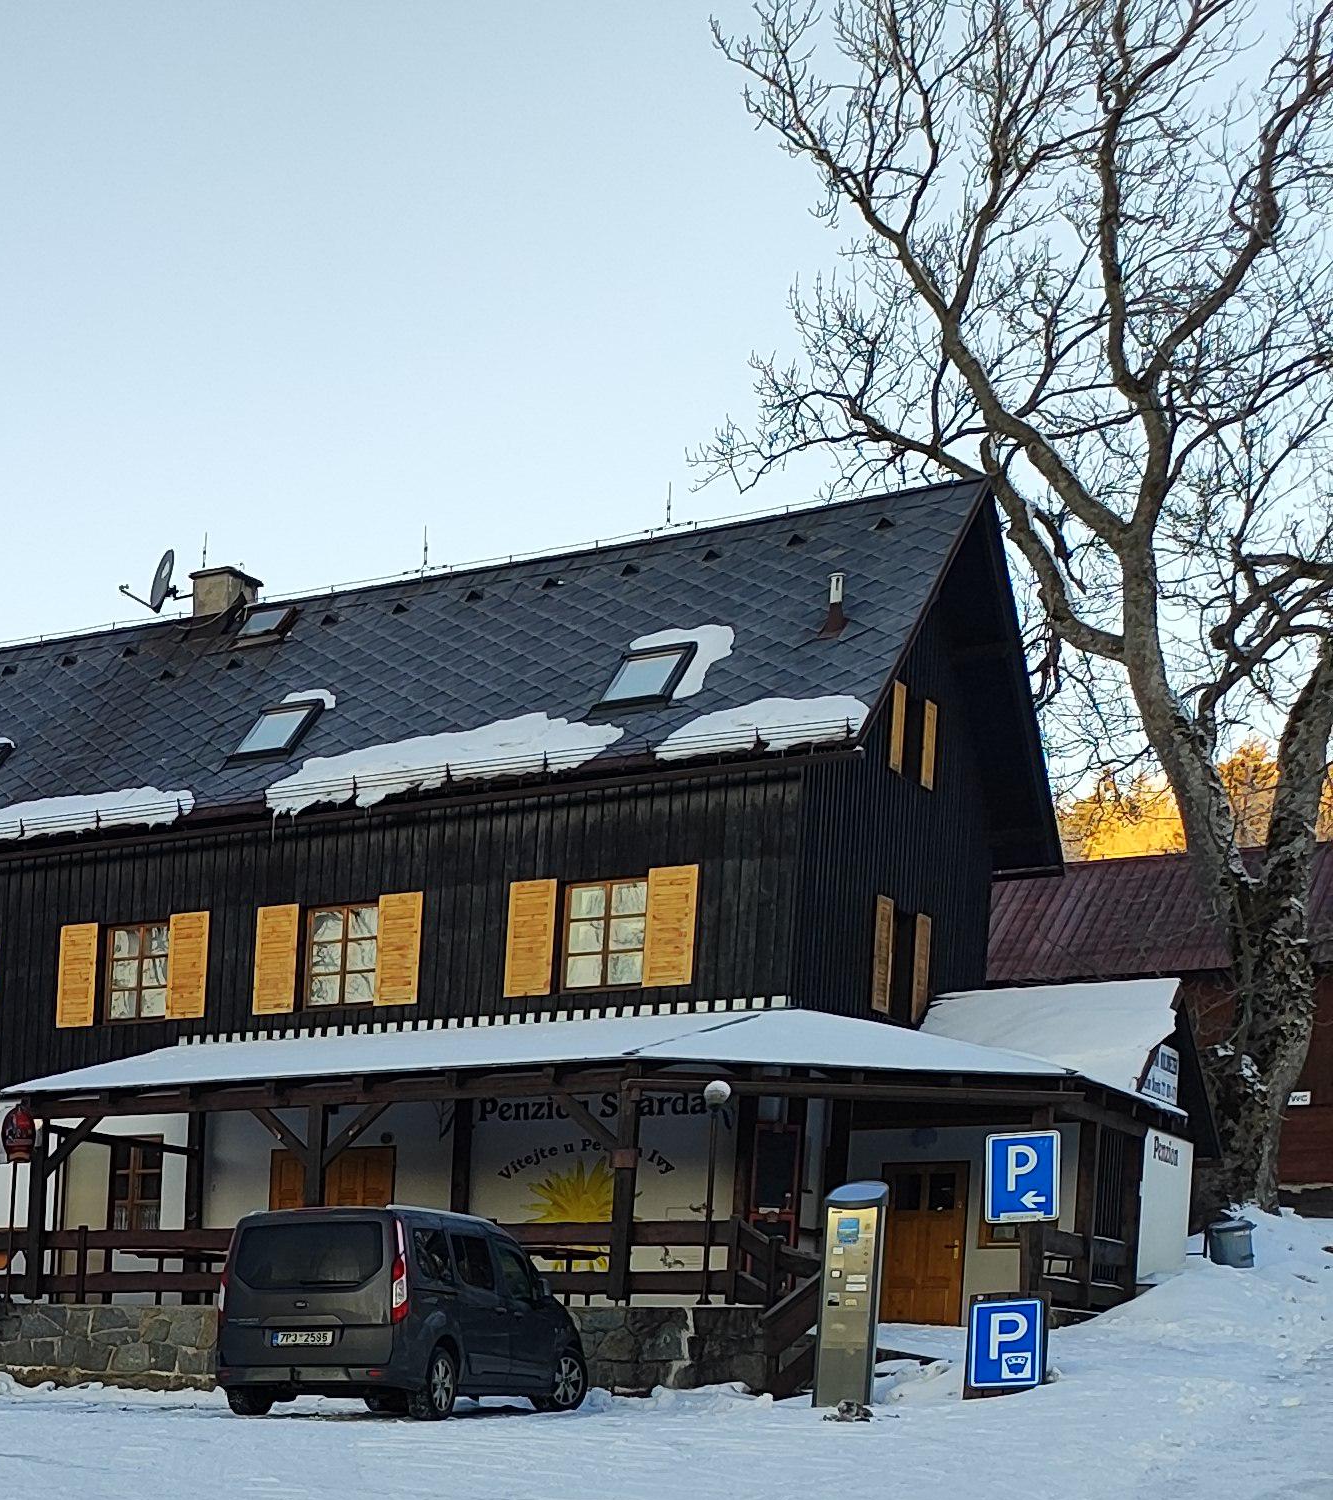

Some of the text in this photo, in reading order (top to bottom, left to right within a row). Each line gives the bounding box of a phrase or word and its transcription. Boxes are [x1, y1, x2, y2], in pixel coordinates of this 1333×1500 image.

[1289, 1094, 1309, 1103] WC
[563, 1142, 575, 1154] u
[647, 1148, 676, 1175] Ivy
[1007, 1145, 1038, 1191] P
[989, 1312, 1028, 1360] P
